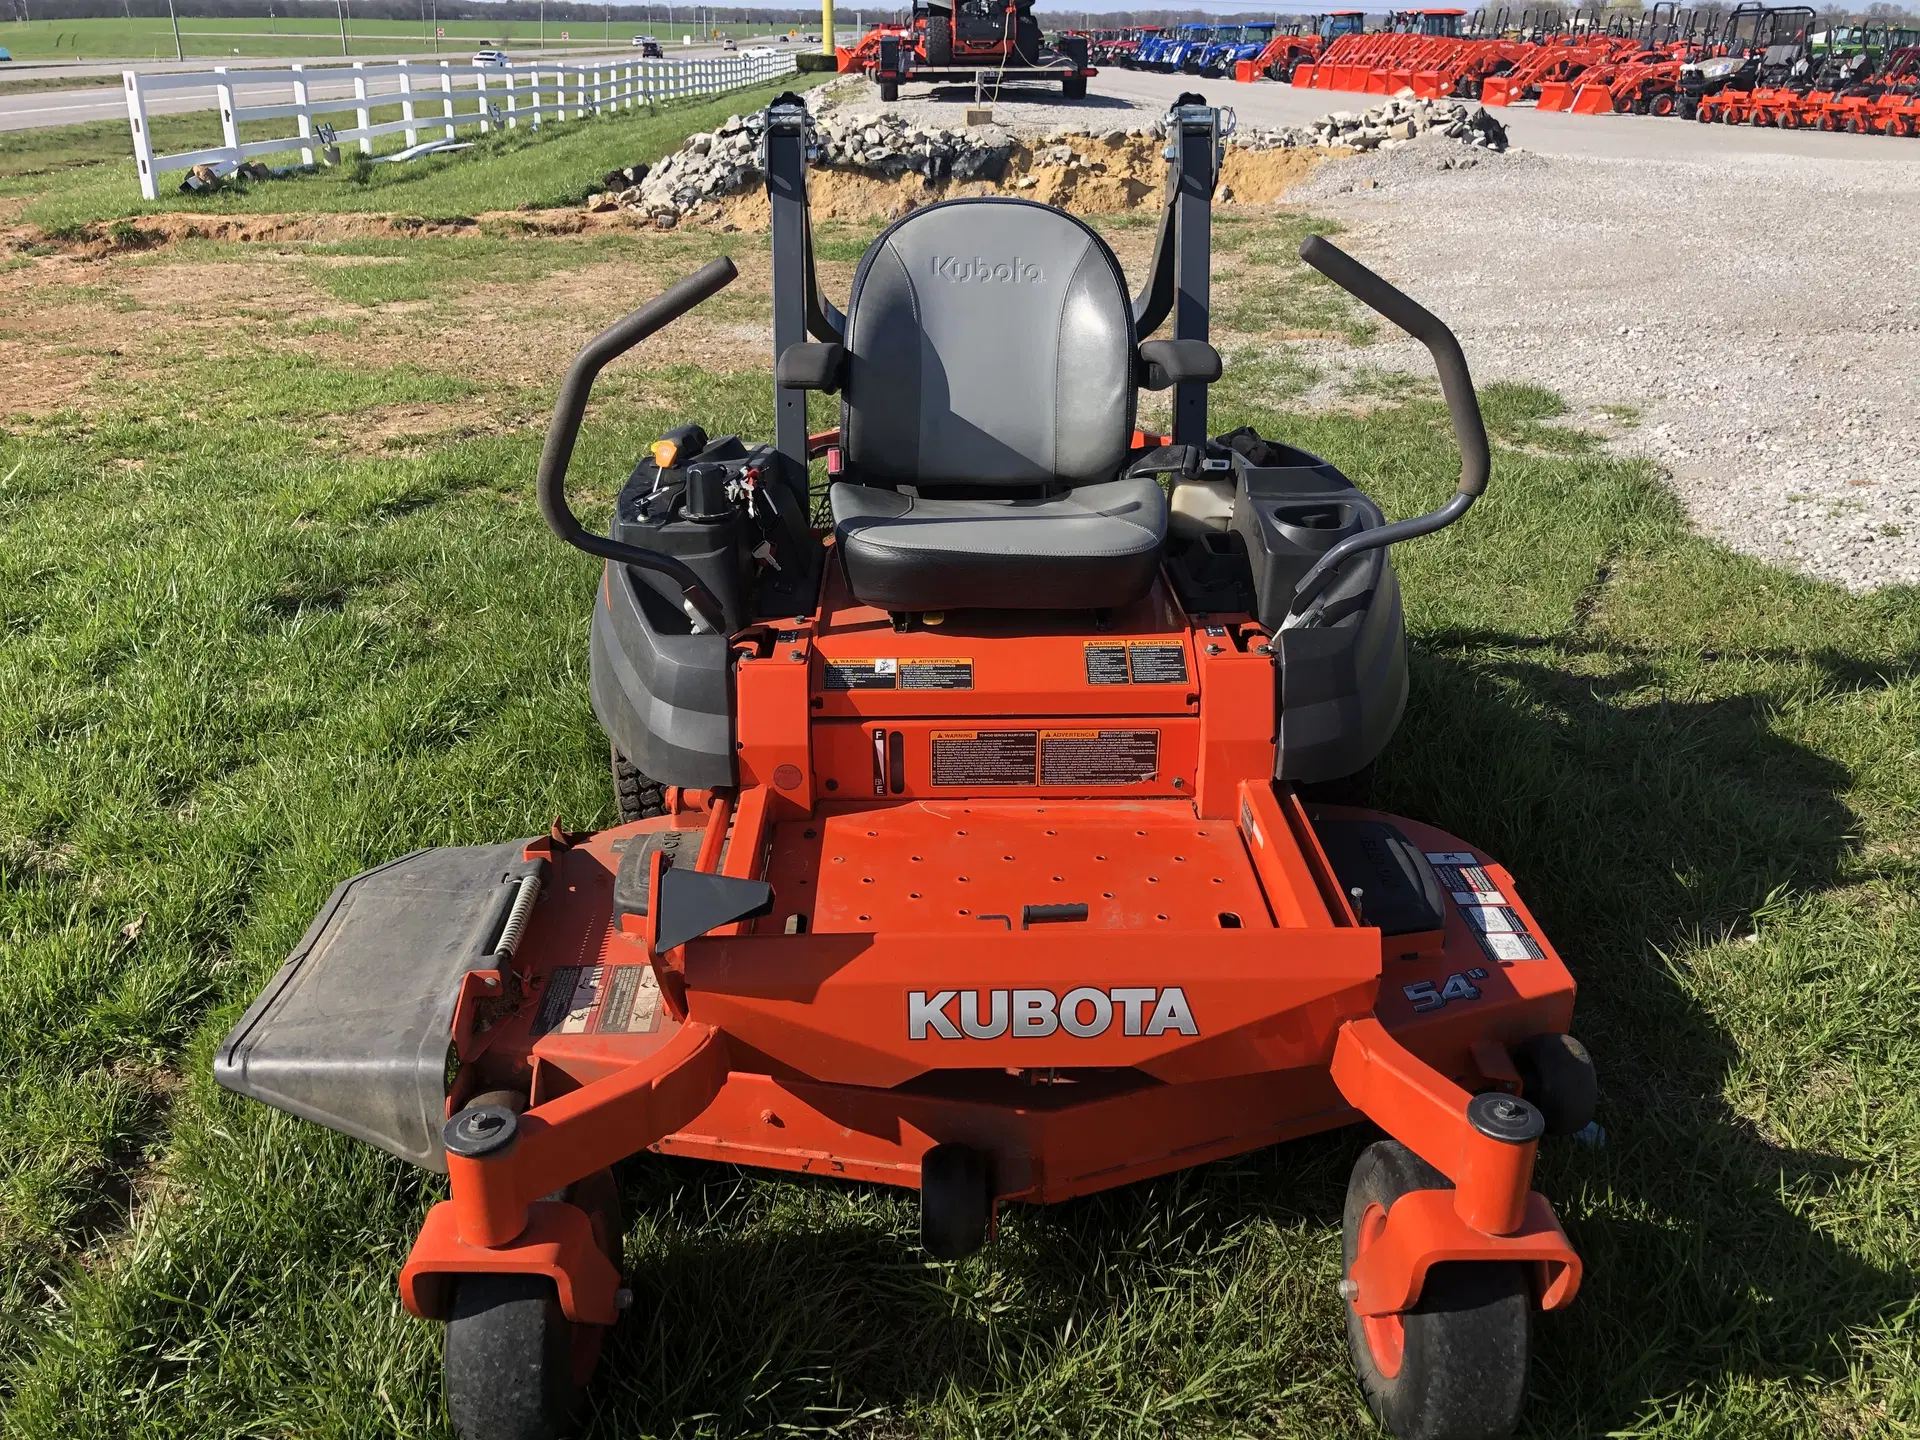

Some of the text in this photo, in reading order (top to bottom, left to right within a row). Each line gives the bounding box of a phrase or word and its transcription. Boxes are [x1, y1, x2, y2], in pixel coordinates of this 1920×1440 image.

[932, 256, 1044, 283] Kubota
[875, 731, 883, 740] F
[876, 786, 884, 794] E
[907, 986, 1200, 1041] KUBOTA
